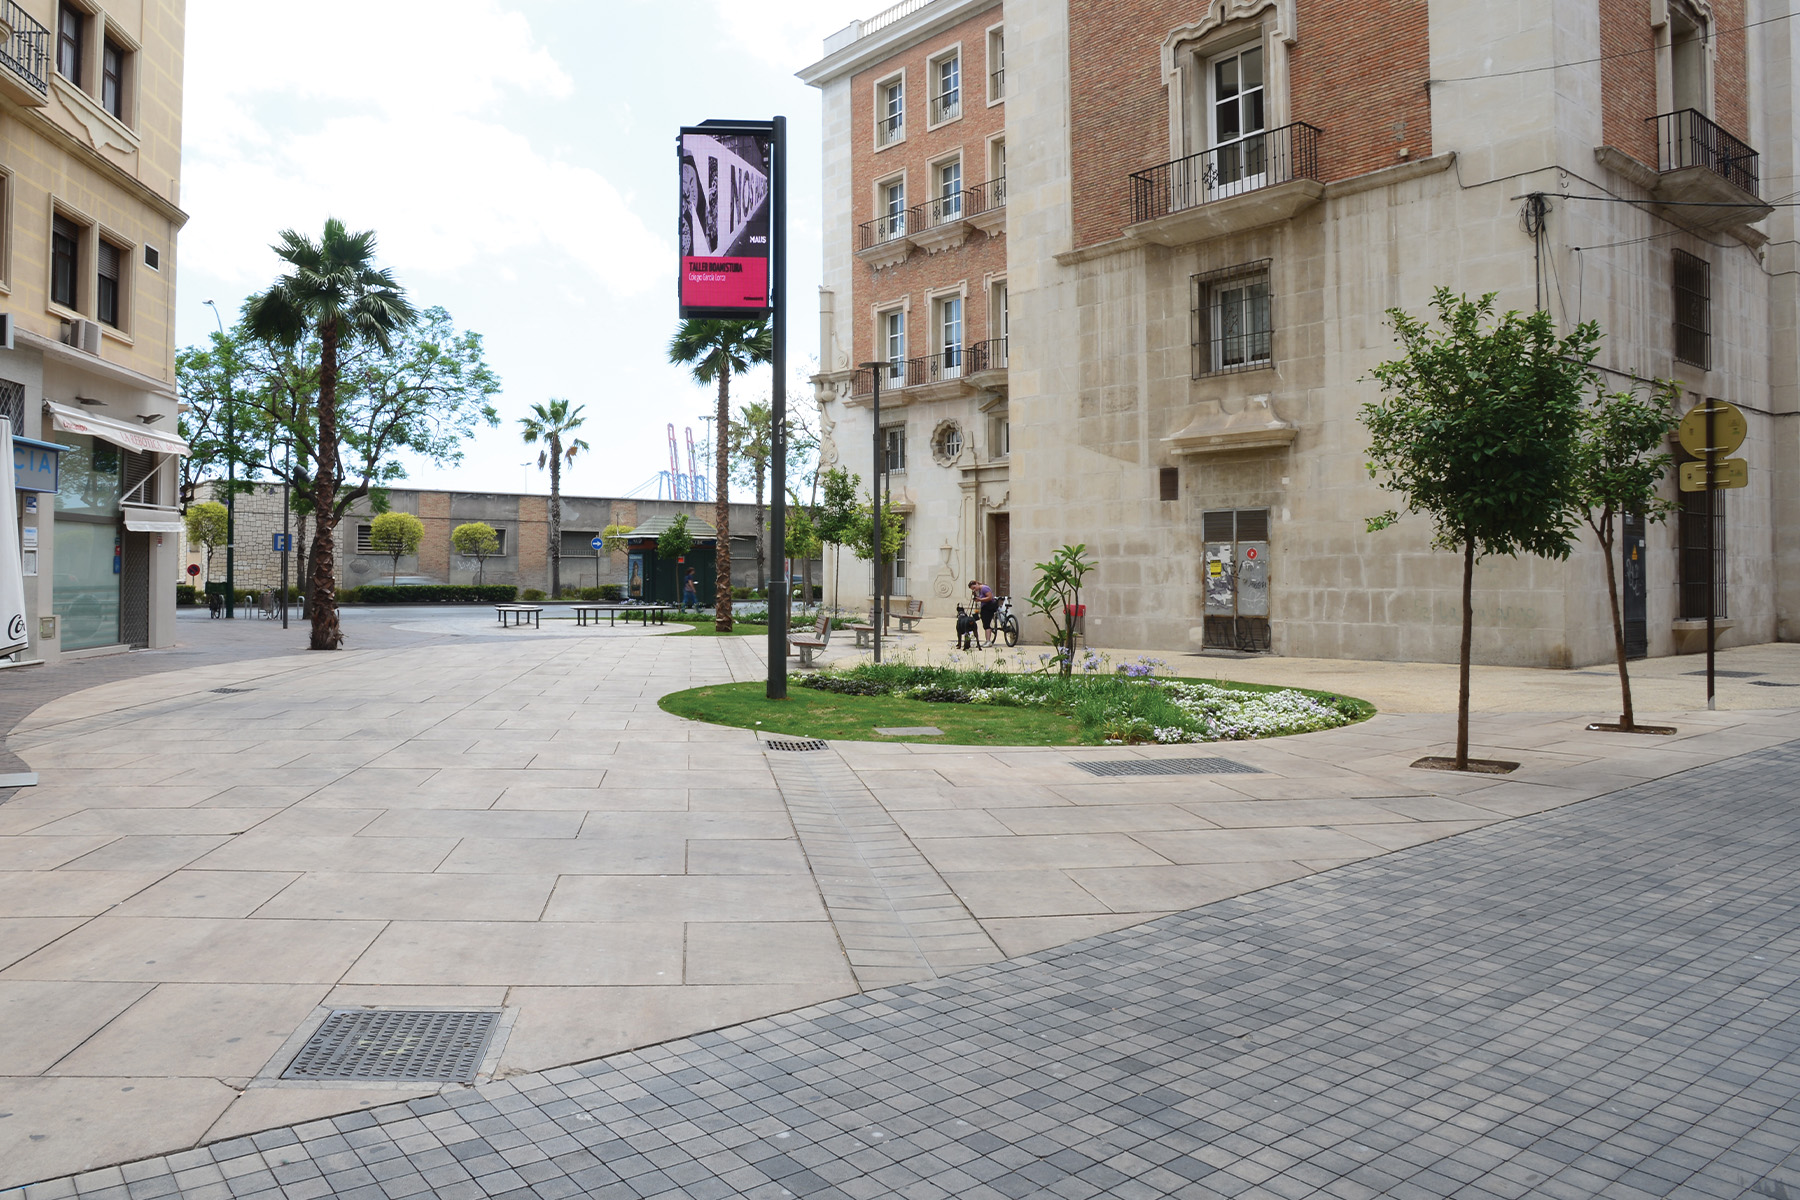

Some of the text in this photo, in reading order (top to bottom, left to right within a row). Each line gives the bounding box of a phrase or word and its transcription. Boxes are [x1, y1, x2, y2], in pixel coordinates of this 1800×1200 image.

[749, 236, 767, 244] MAUS
[689, 262, 743, 273] TALLER BOAMISTURA
[688, 273, 703, 283] Colegio
[119, 431, 130, 443] LA
[130, 433, 162, 450] REBOTICA
